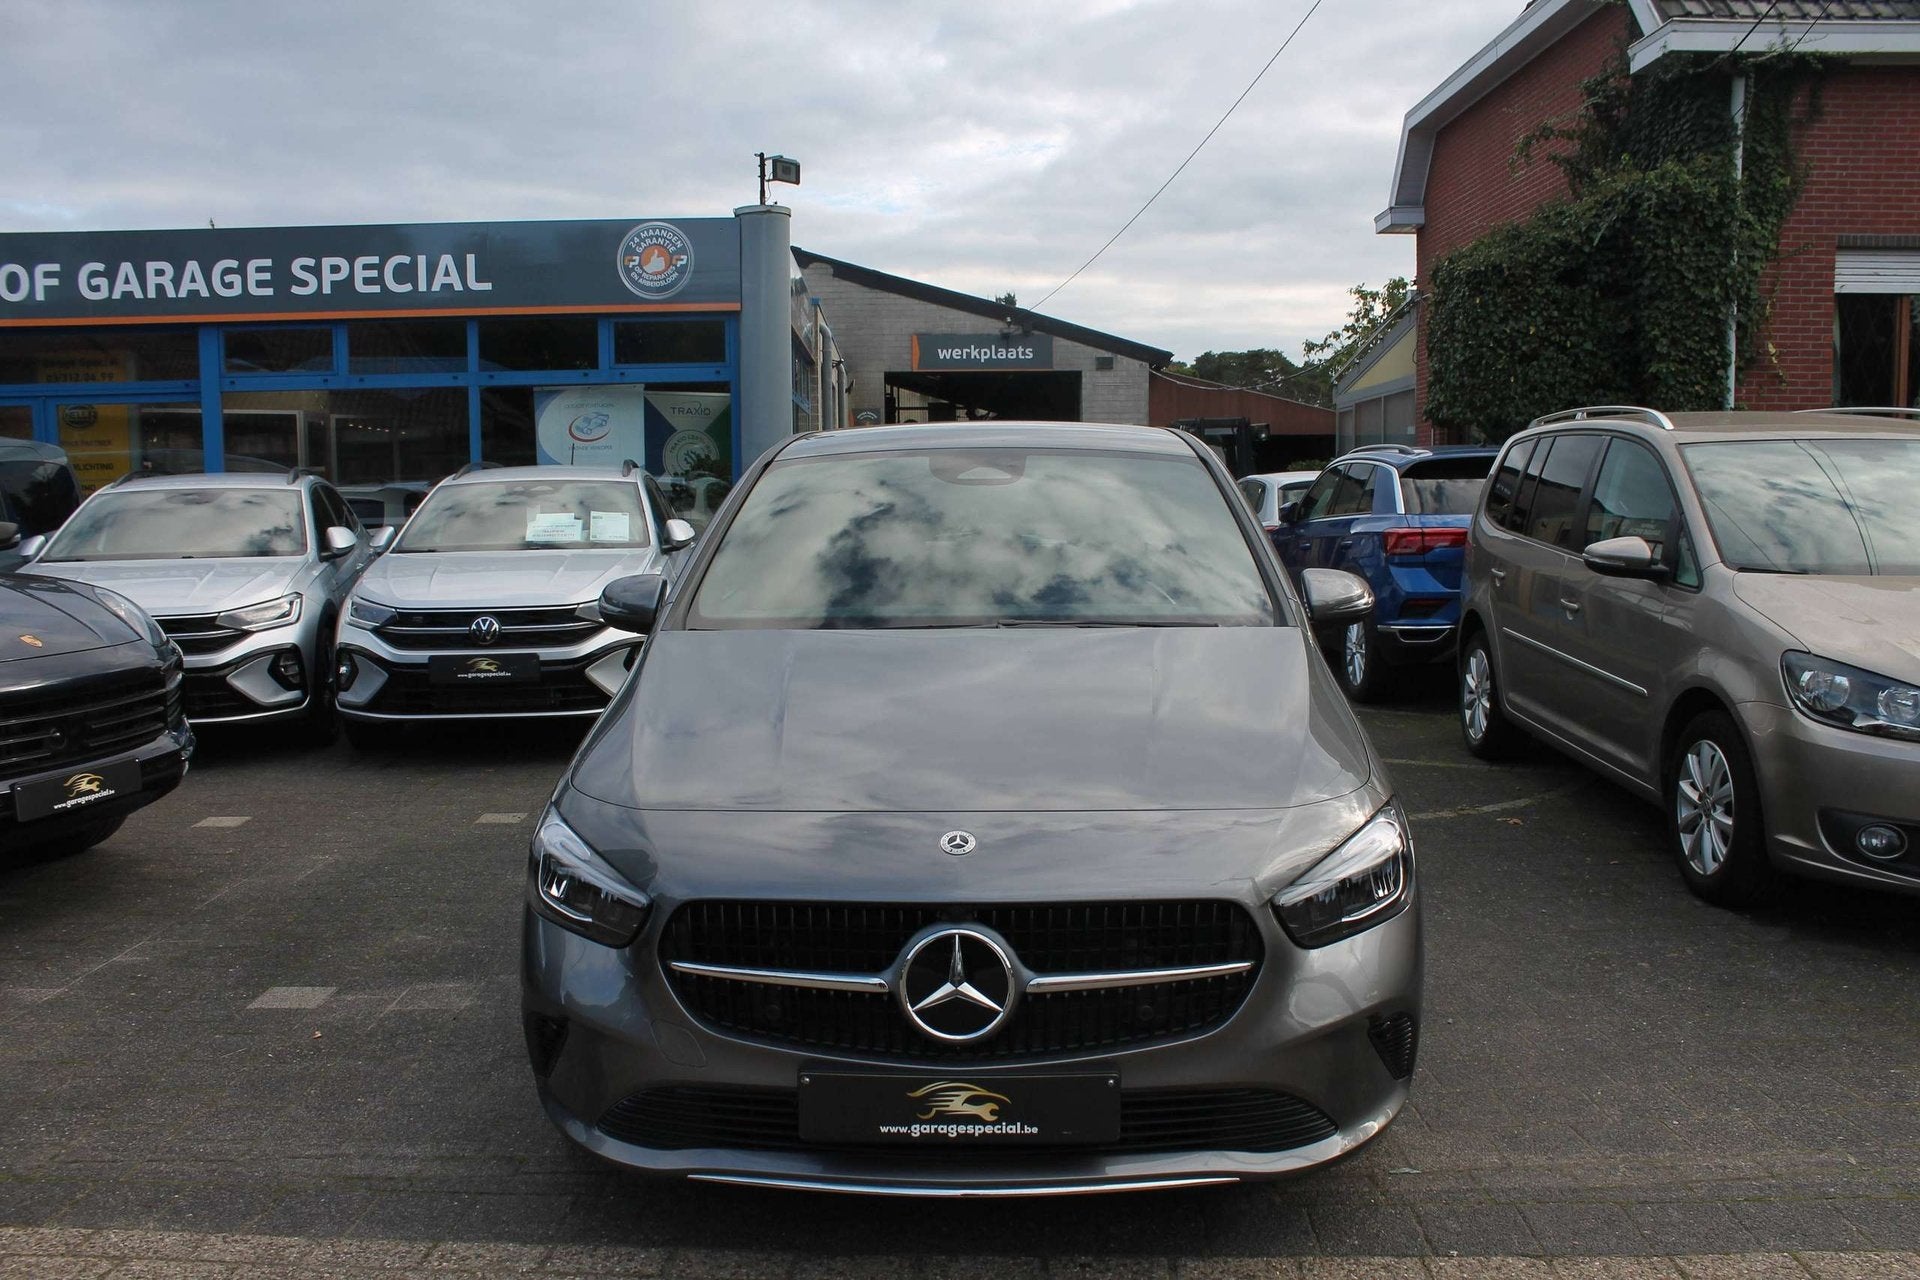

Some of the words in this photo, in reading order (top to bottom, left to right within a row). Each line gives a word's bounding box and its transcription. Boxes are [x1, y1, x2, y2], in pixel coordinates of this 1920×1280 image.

[629, 236, 640, 248] 24
[640, 228, 684, 249] MAANDEN
[635, 237, 677, 253] GARANTIE
[0, 263, 61, 302] OF
[78, 258, 274, 301] GARAGE
[290, 253, 493, 296] SPECIAL
[938, 345, 1033, 363] werkplaats
[670, 406, 712, 416] TRAXIO
[53, 788, 115, 809] www.garagespecial.be
[880, 1122, 1038, 1137] www.garagespecial.be
